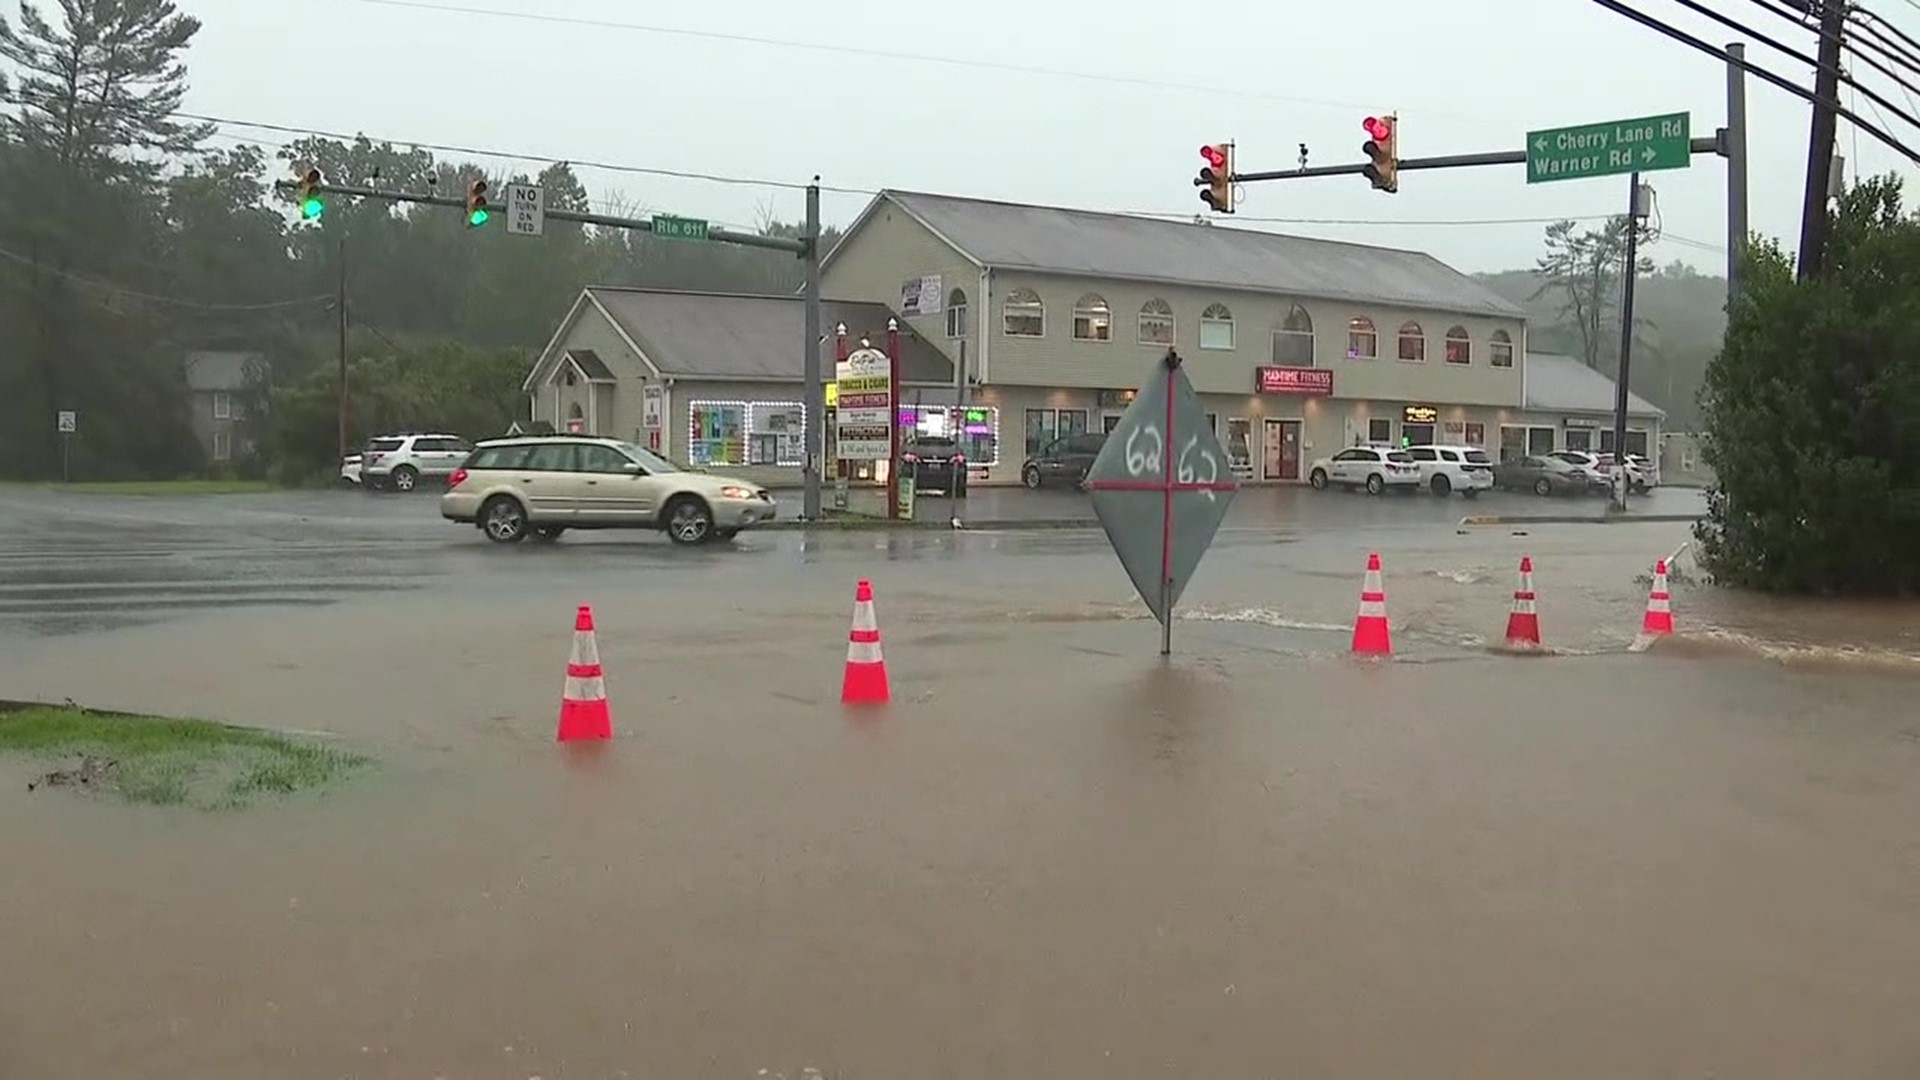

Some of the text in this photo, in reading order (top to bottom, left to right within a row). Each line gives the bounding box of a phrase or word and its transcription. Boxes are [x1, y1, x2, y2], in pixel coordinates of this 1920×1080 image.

[1557, 119, 1682, 150] Cherry Lane Rd
[1534, 148, 1632, 175] Warner Rd
[516, 188, 537, 201] NO
[514, 201, 538, 211] TURN
[518, 212, 532, 221] ON
[517, 222, 534, 232] RED
[657, 220, 704, 236] Rte 611
[1300, 372, 1331, 384] FITNESS
[1125, 425, 1162, 477] 62
